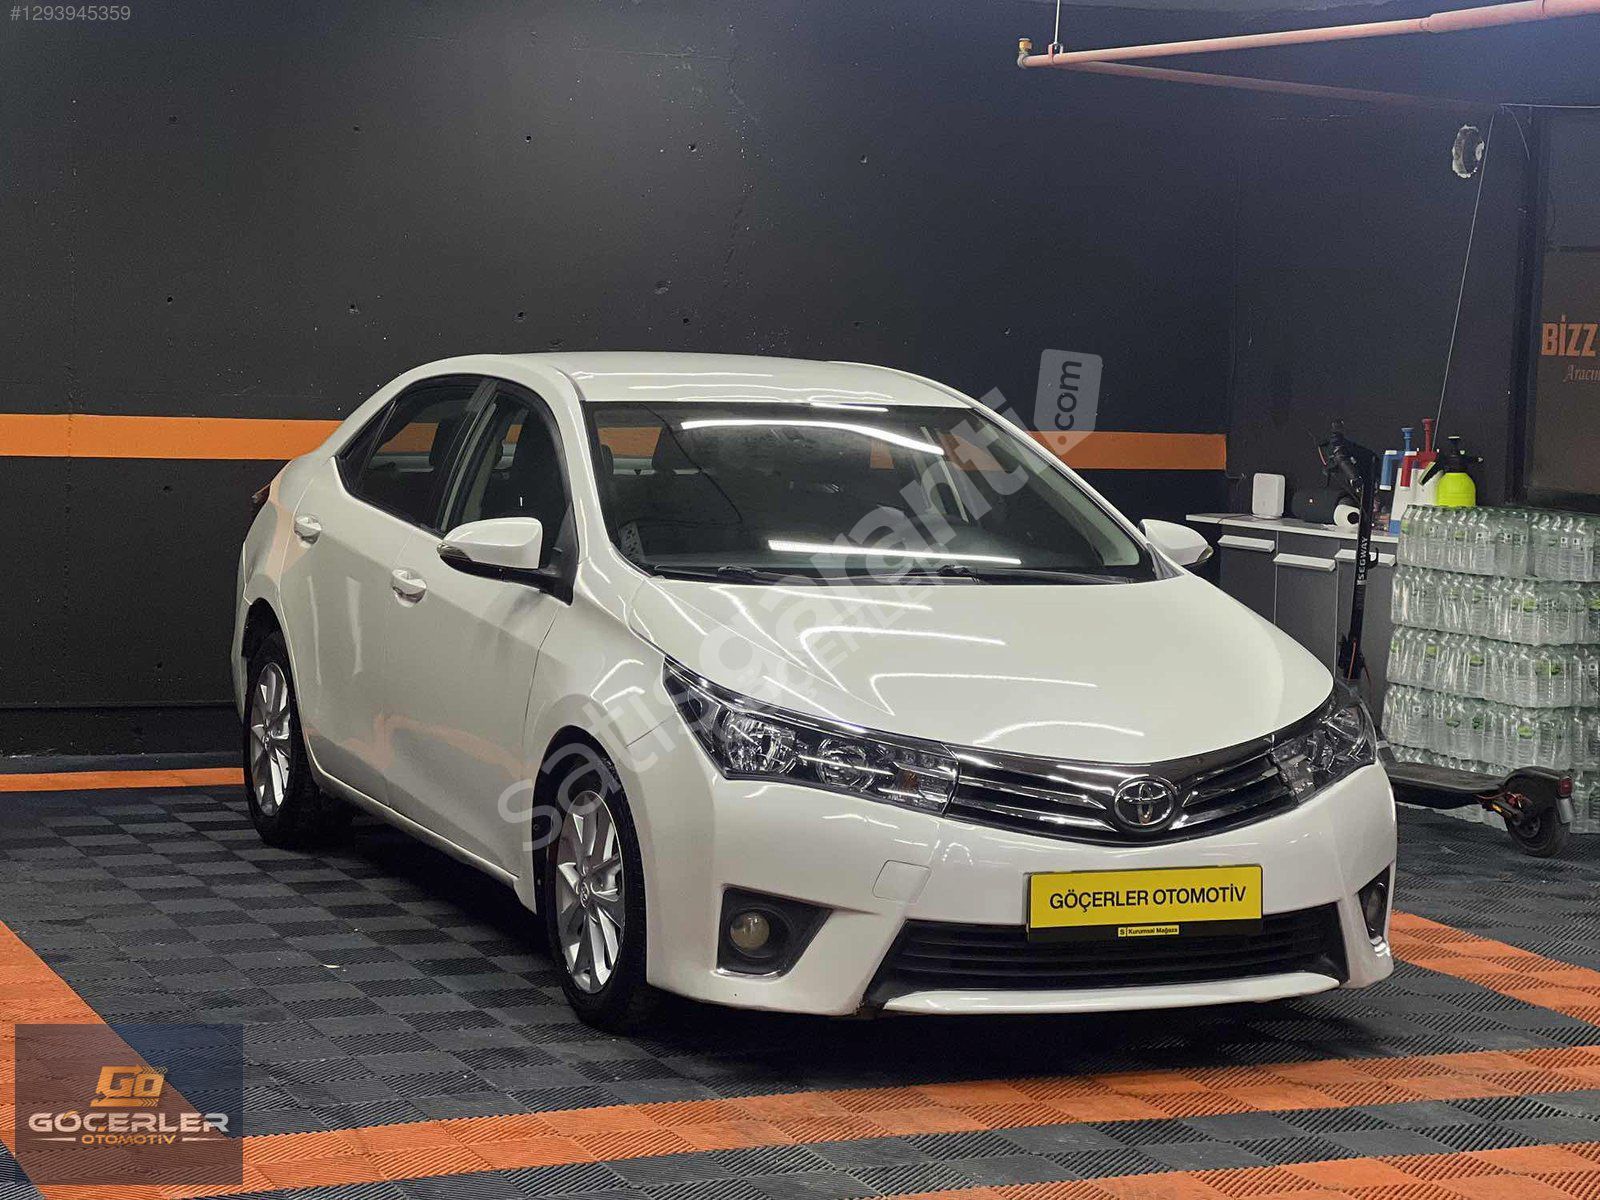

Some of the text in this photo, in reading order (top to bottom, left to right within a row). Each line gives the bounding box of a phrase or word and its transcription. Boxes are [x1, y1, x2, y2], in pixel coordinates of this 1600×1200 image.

[1357, 535, 1368, 580] SEGWAY
[1050, 883, 1247, 912] GÖÇERLER OTOMOTİV
[1128, 927, 1155, 935] Kurumsal
[1156, 926, 1178, 934] Mağaza
